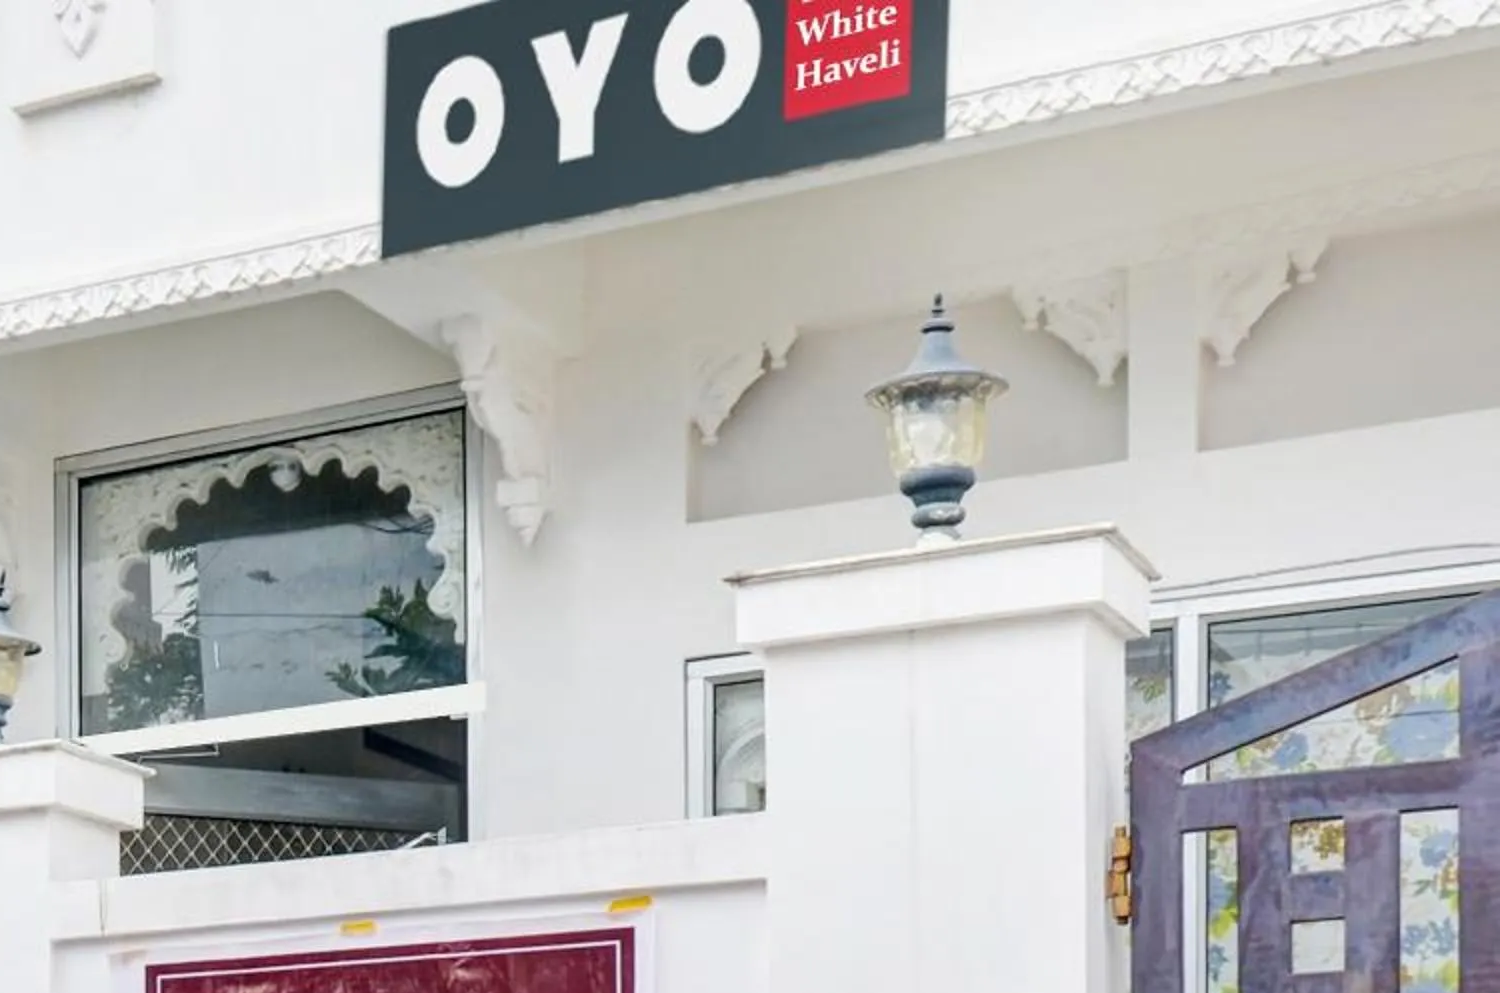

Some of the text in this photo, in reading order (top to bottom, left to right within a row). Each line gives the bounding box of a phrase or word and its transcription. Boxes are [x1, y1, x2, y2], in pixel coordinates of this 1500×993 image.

[795, 5, 898, 46] White
[795, 38, 901, 91] Haveli
[416, 0, 762, 188] OYO
